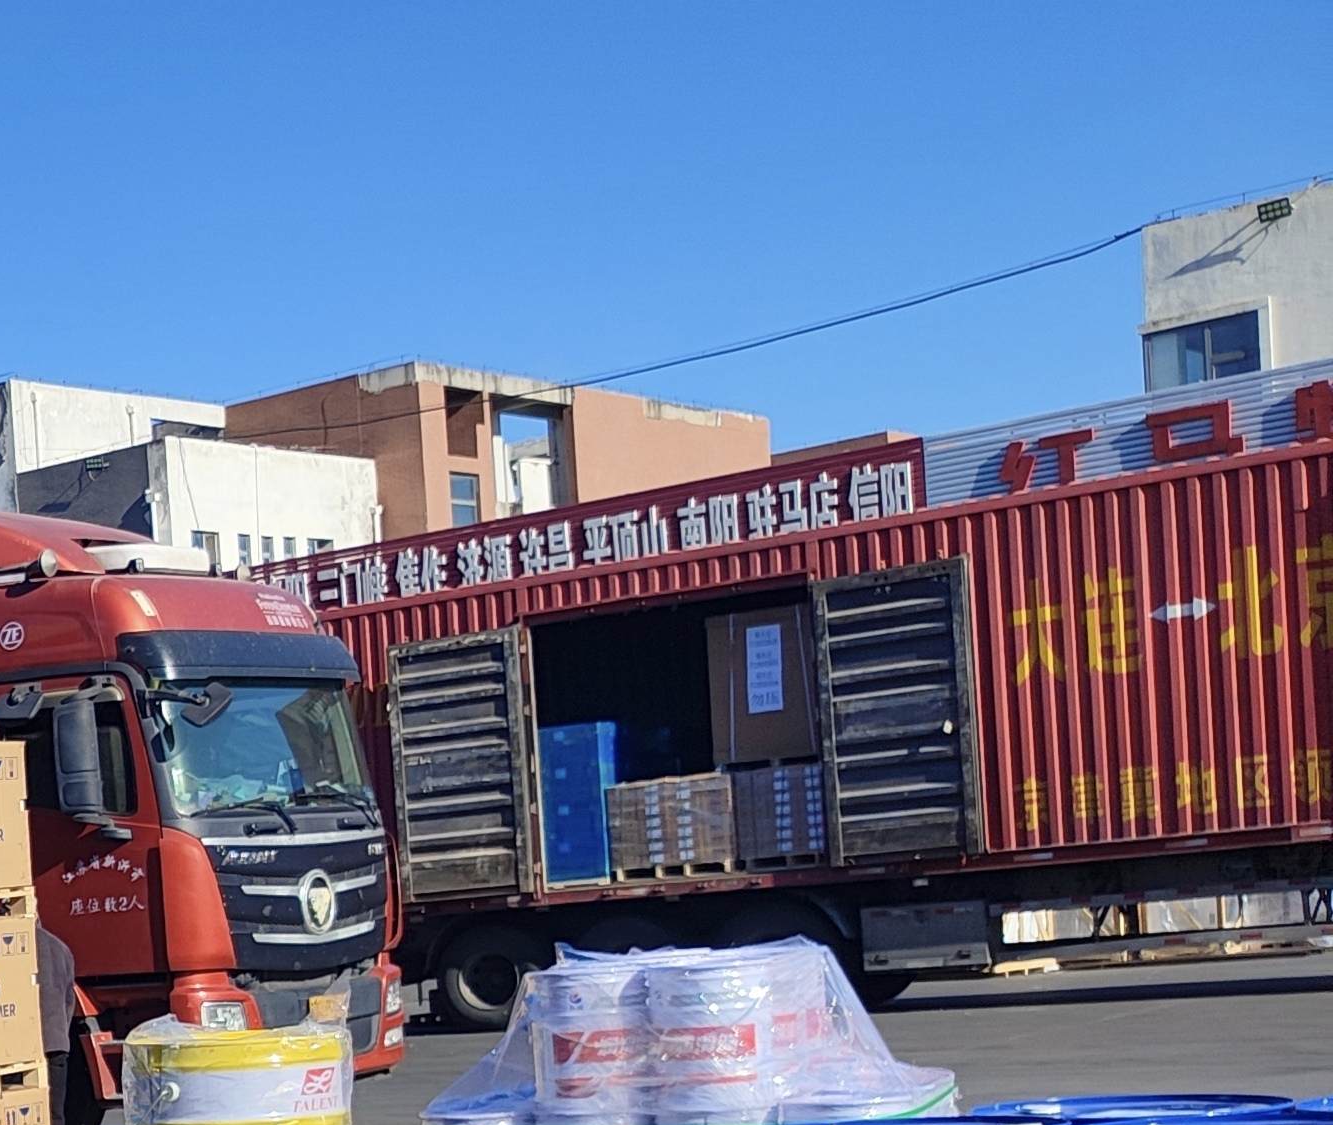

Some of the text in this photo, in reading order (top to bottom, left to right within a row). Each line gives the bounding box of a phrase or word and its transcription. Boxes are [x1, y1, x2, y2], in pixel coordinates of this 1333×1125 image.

[394, 546, 448, 598] 焦作
[457, 534, 513, 586] 济源
[519, 520, 575, 574] 许昌
[583, 505, 668, 565] 平顶山
[677, 493, 740, 549] 南阳
[746, 472, 838, 540] 驻马店
[848, 461, 914, 522] 信阳
[1, 624, 23, 648] ZF
[1010, 567, 1145, 686] 大连
[293, 1096, 339, 1113] TALENT
